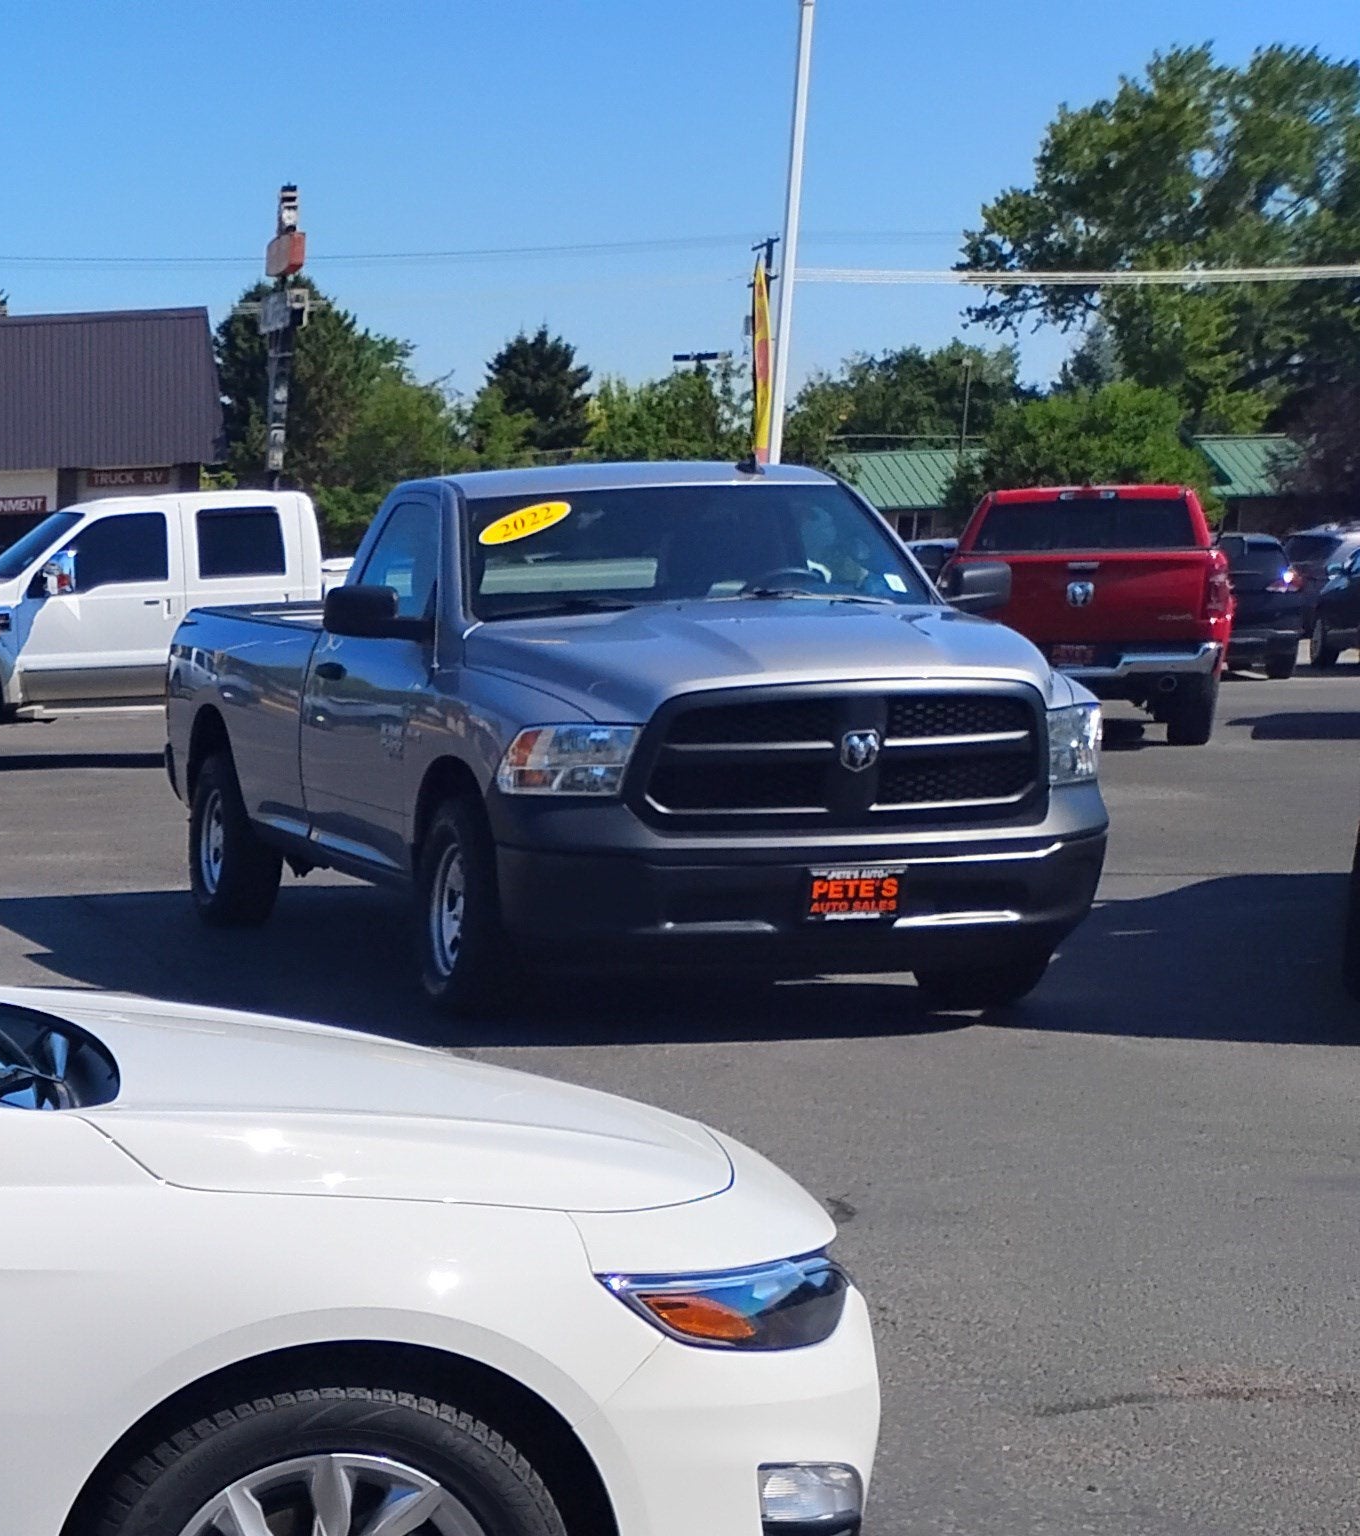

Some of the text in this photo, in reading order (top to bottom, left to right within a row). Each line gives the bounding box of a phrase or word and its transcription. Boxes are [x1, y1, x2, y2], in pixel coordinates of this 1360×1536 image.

[92, 470, 165, 485] TRUCK RV
[500, 507, 553, 537] 2022
[812, 878, 898, 899] PETE'S
[810, 900, 897, 913] AUTO SALES
